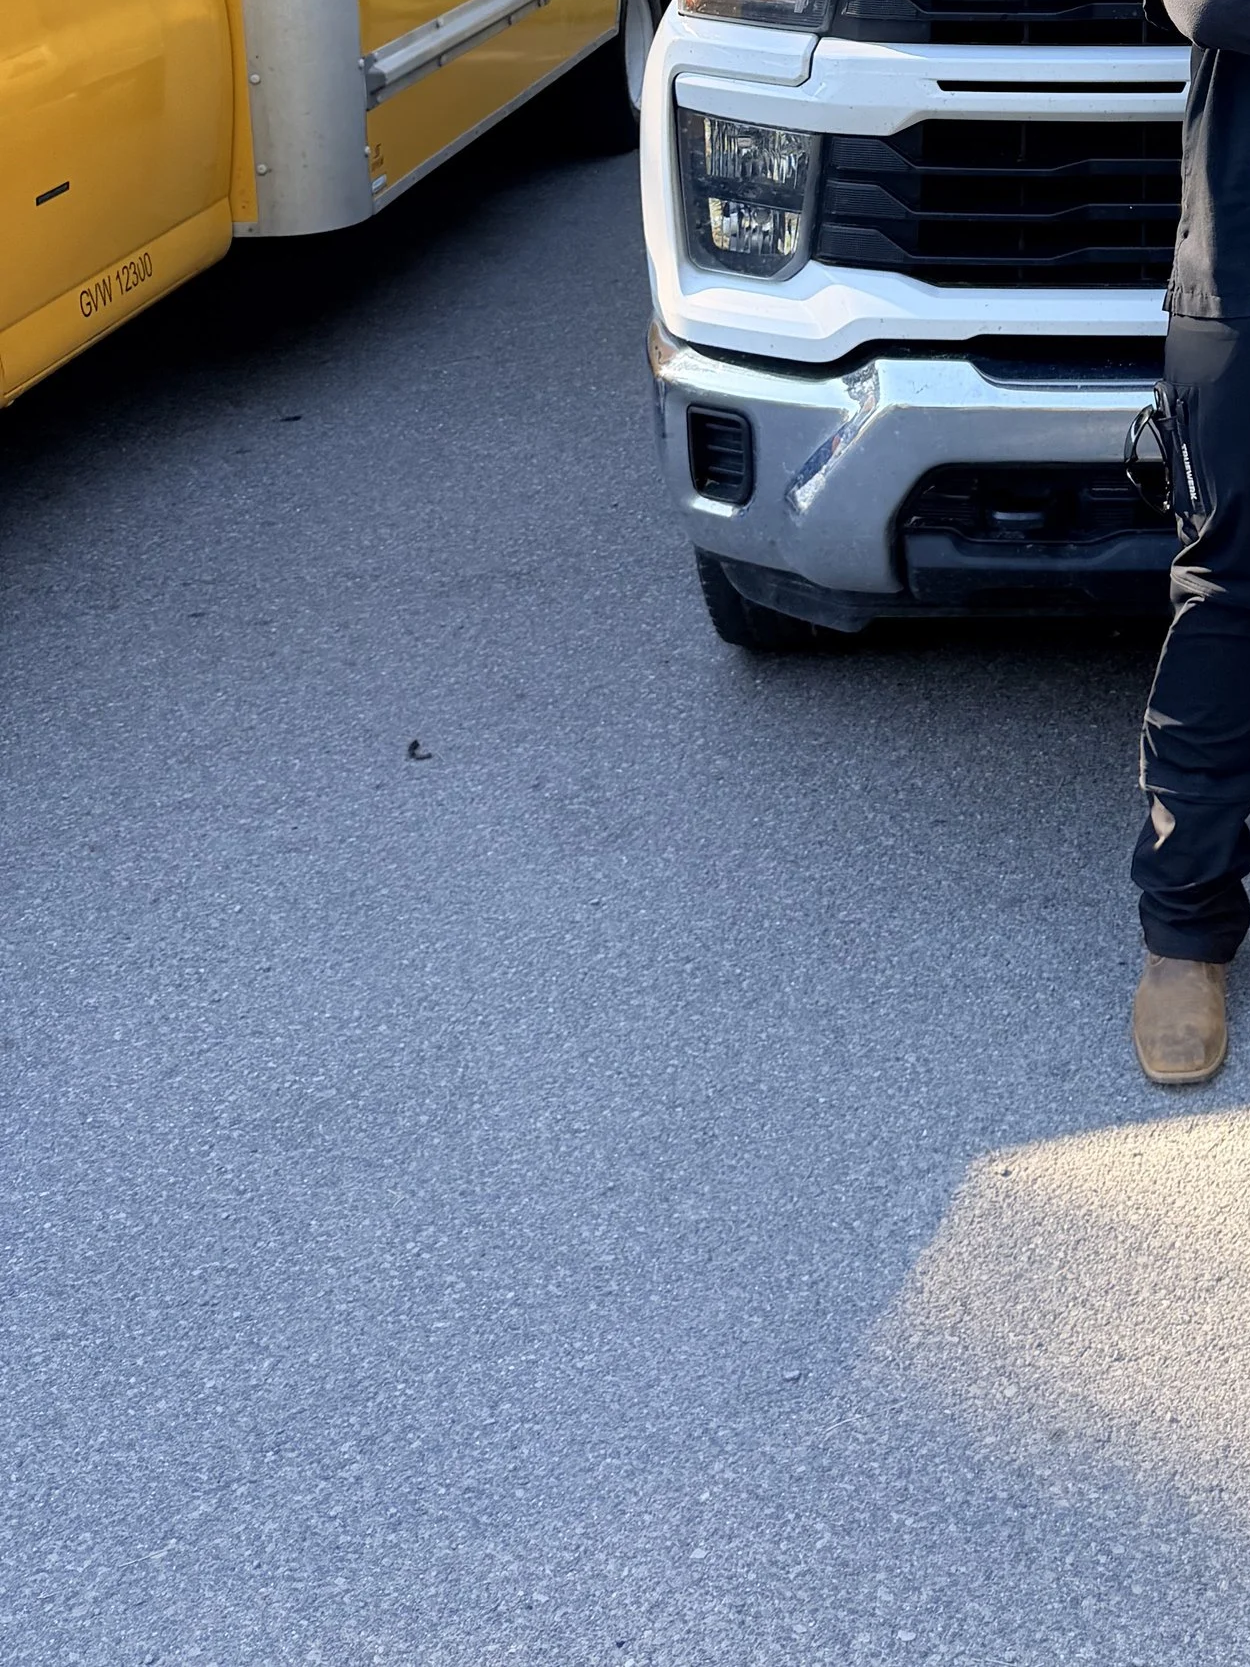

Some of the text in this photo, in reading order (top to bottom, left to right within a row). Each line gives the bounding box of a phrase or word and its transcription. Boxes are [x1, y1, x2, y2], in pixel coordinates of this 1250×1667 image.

[79, 252, 153, 318] GVW 12300
[1181, 443, 1198, 501] TRUEWERK
